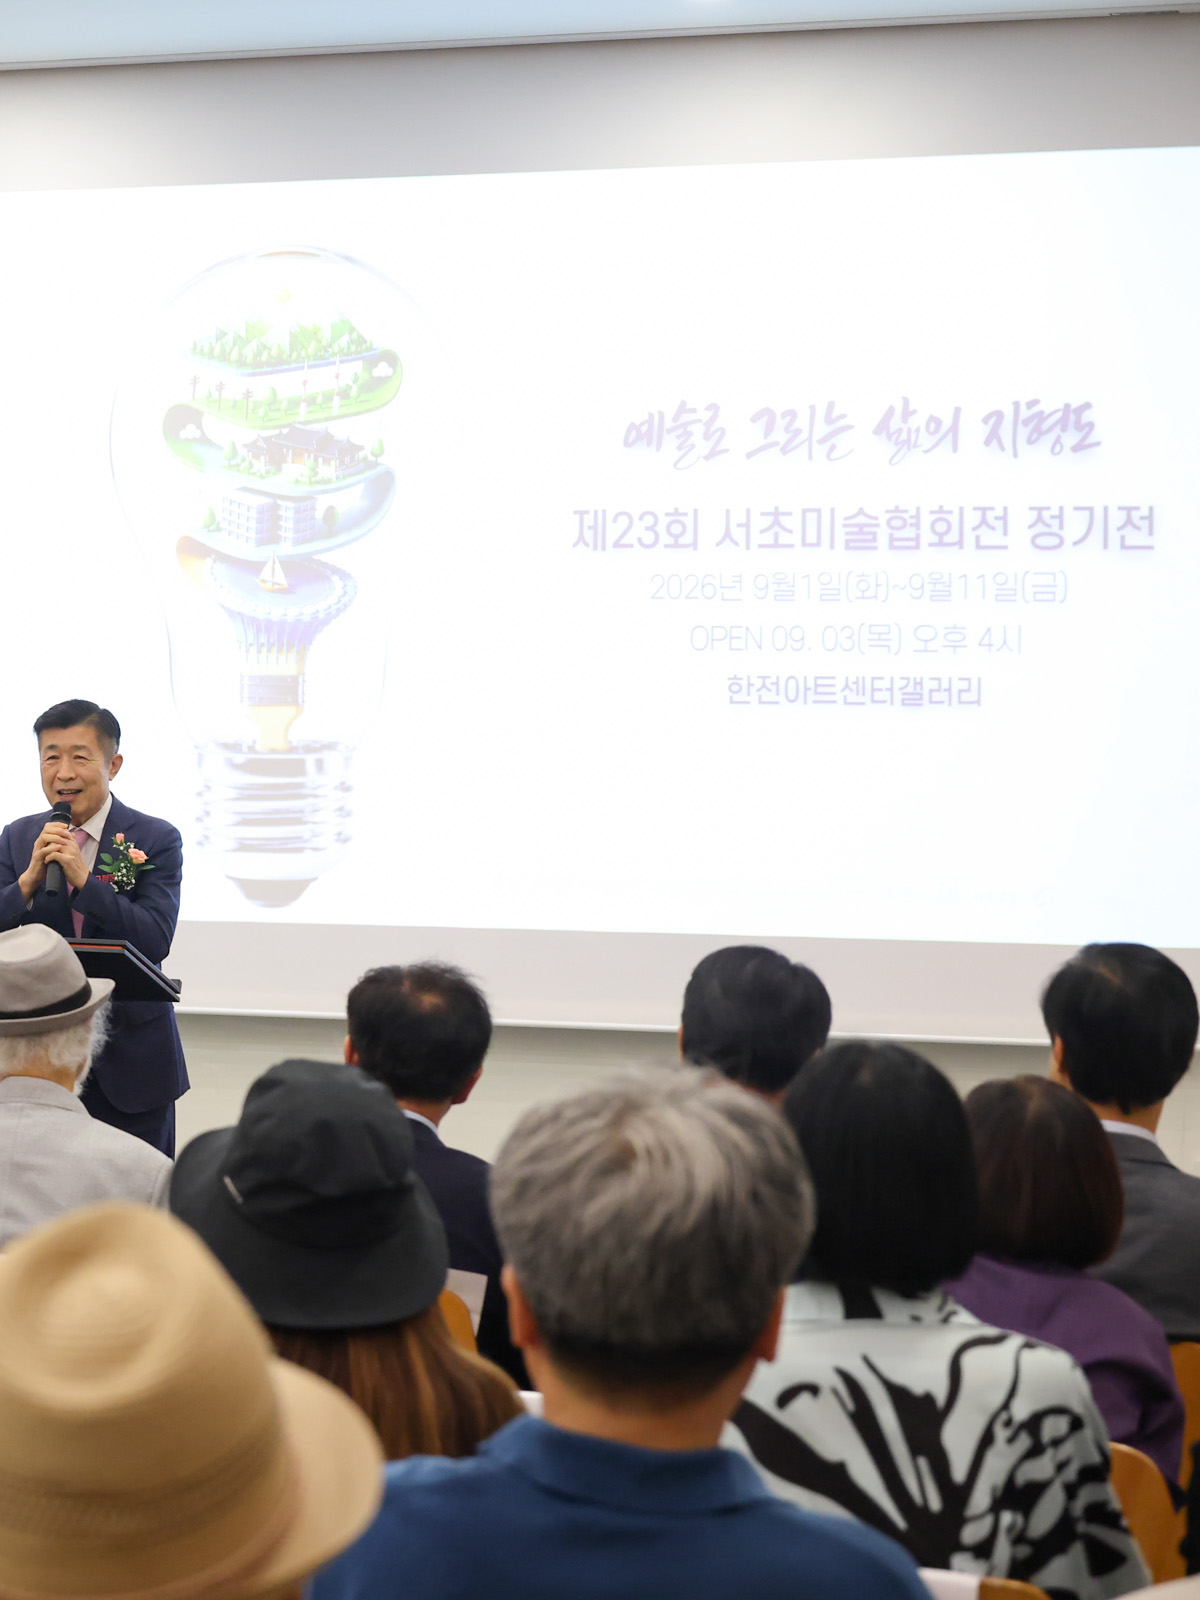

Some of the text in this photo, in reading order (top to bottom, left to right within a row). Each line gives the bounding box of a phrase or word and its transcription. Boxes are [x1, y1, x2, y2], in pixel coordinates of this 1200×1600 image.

[622, 396, 1104, 471] 예술로 그리는 삶의 지형도
[571, 504, 1157, 552] 제23회 서초미술협회전 정기전
[649, 570, 1069, 605] 2026년 9월1일(화)~9월11일(금)
[689, 622, 1024, 657] OPEN 09. 03(목) 오후 4시
[726, 673, 983, 708] 한전아트센터갤러리
